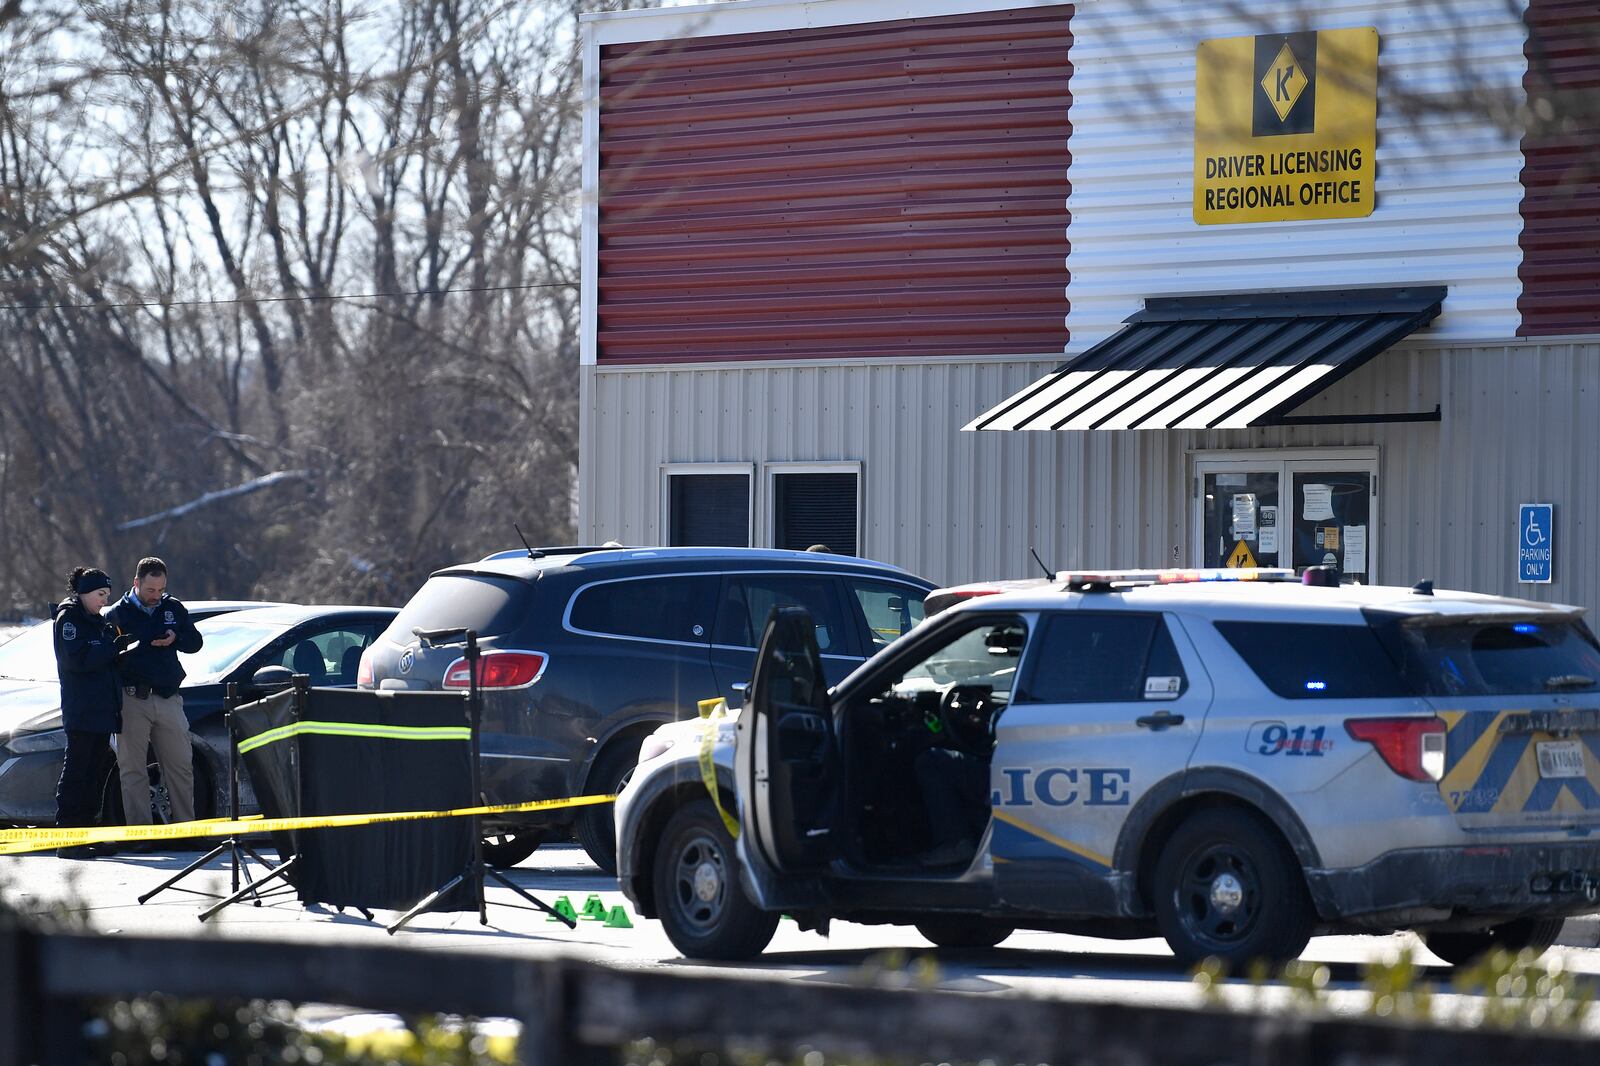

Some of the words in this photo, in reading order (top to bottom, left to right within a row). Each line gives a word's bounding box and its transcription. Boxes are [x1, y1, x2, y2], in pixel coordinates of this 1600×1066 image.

[1206, 155, 1264, 179] DRIVER
[1270, 148, 1362, 175] LICENSING
[1205, 185, 1294, 210] REGIONAL
[1300, 181, 1360, 206] OFFICE
[1521, 548, 1550, 561] PARKING
[1526, 563, 1544, 575] ONLY
[1259, 724, 1326, 757] 911
[991, 767, 1131, 807] ICE
